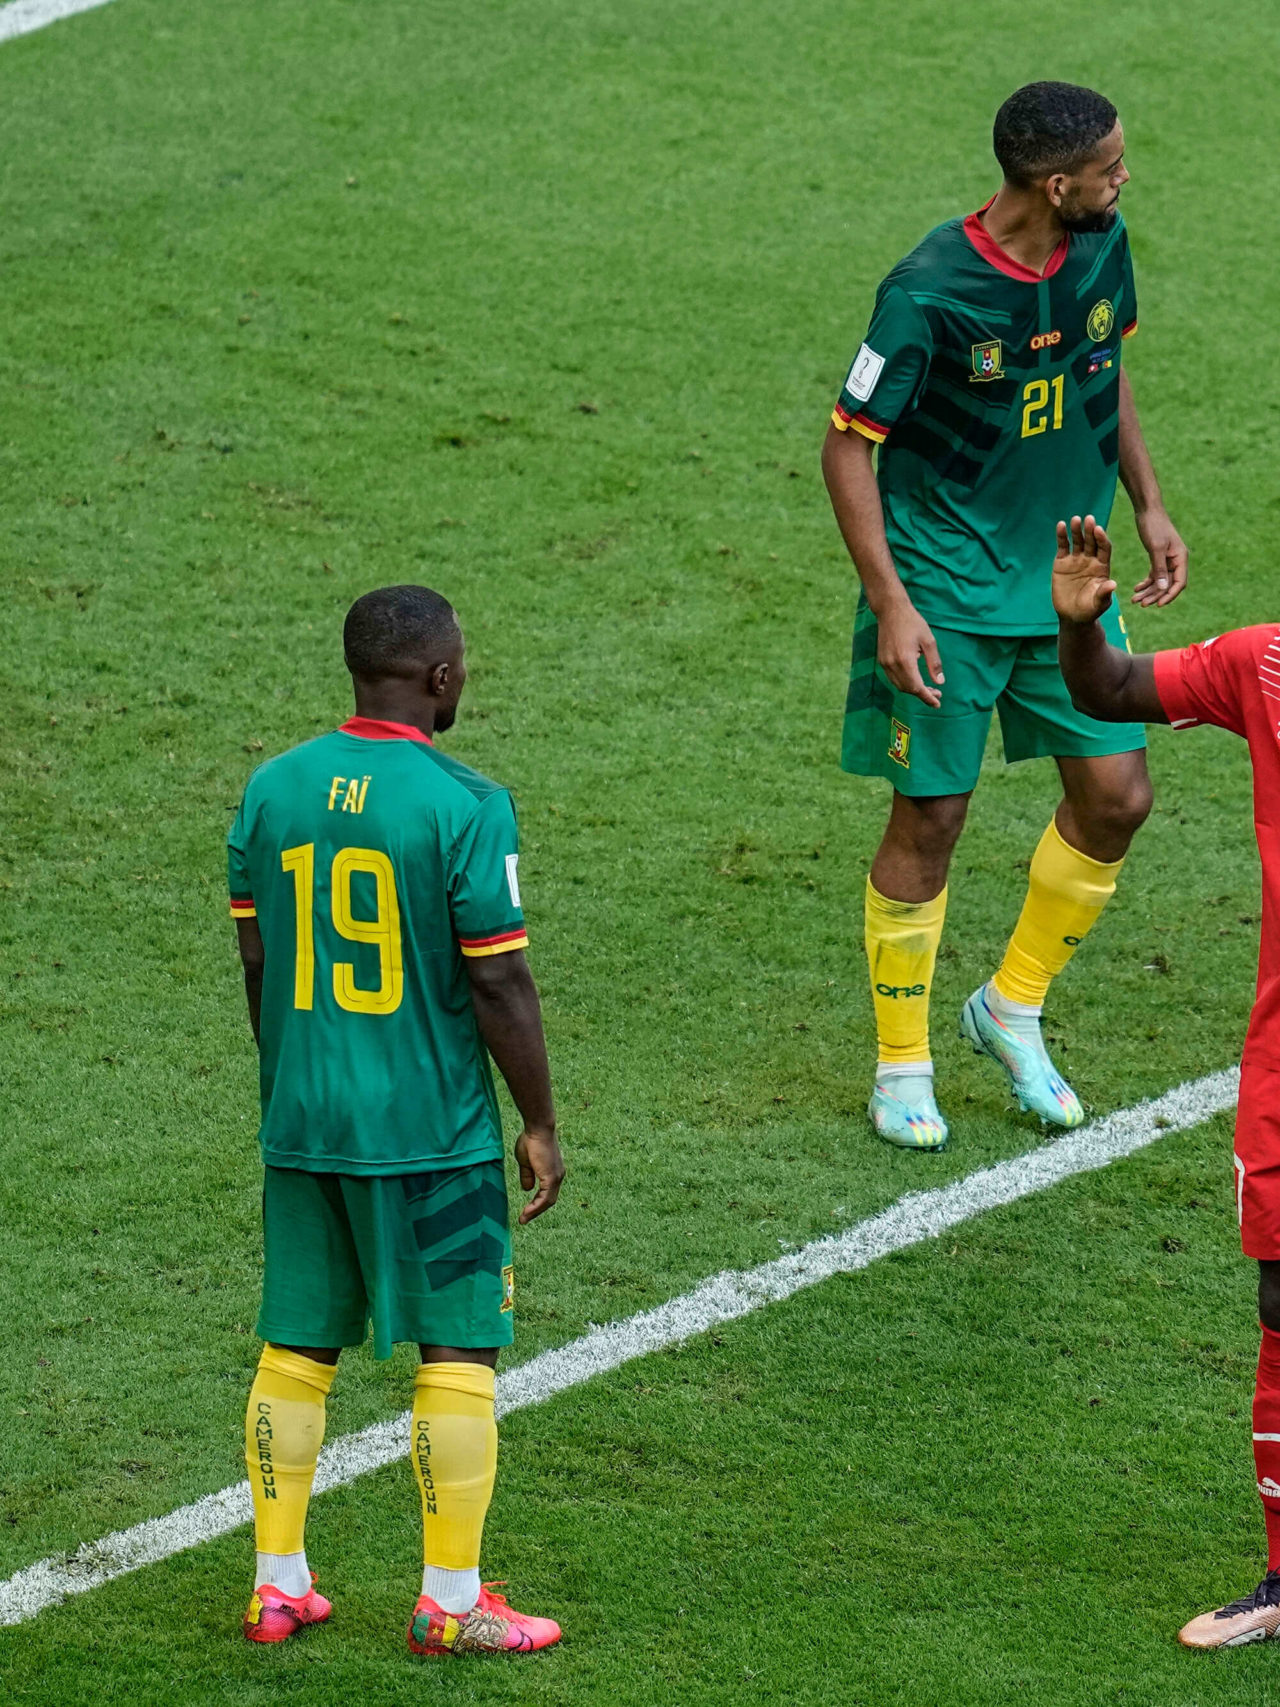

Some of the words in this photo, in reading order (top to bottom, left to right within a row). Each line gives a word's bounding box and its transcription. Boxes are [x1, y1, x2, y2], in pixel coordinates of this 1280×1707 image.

[1030, 330, 1062, 350] one
[1021, 374, 1064, 438] 21
[328, 775, 372, 814] FAÏ
[281, 843, 403, 1015] 19
[876, 983, 926, 999] one
[256, 1402, 277, 1500] CAMEROUN
[417, 1420, 438, 1515] CAMEROUN
